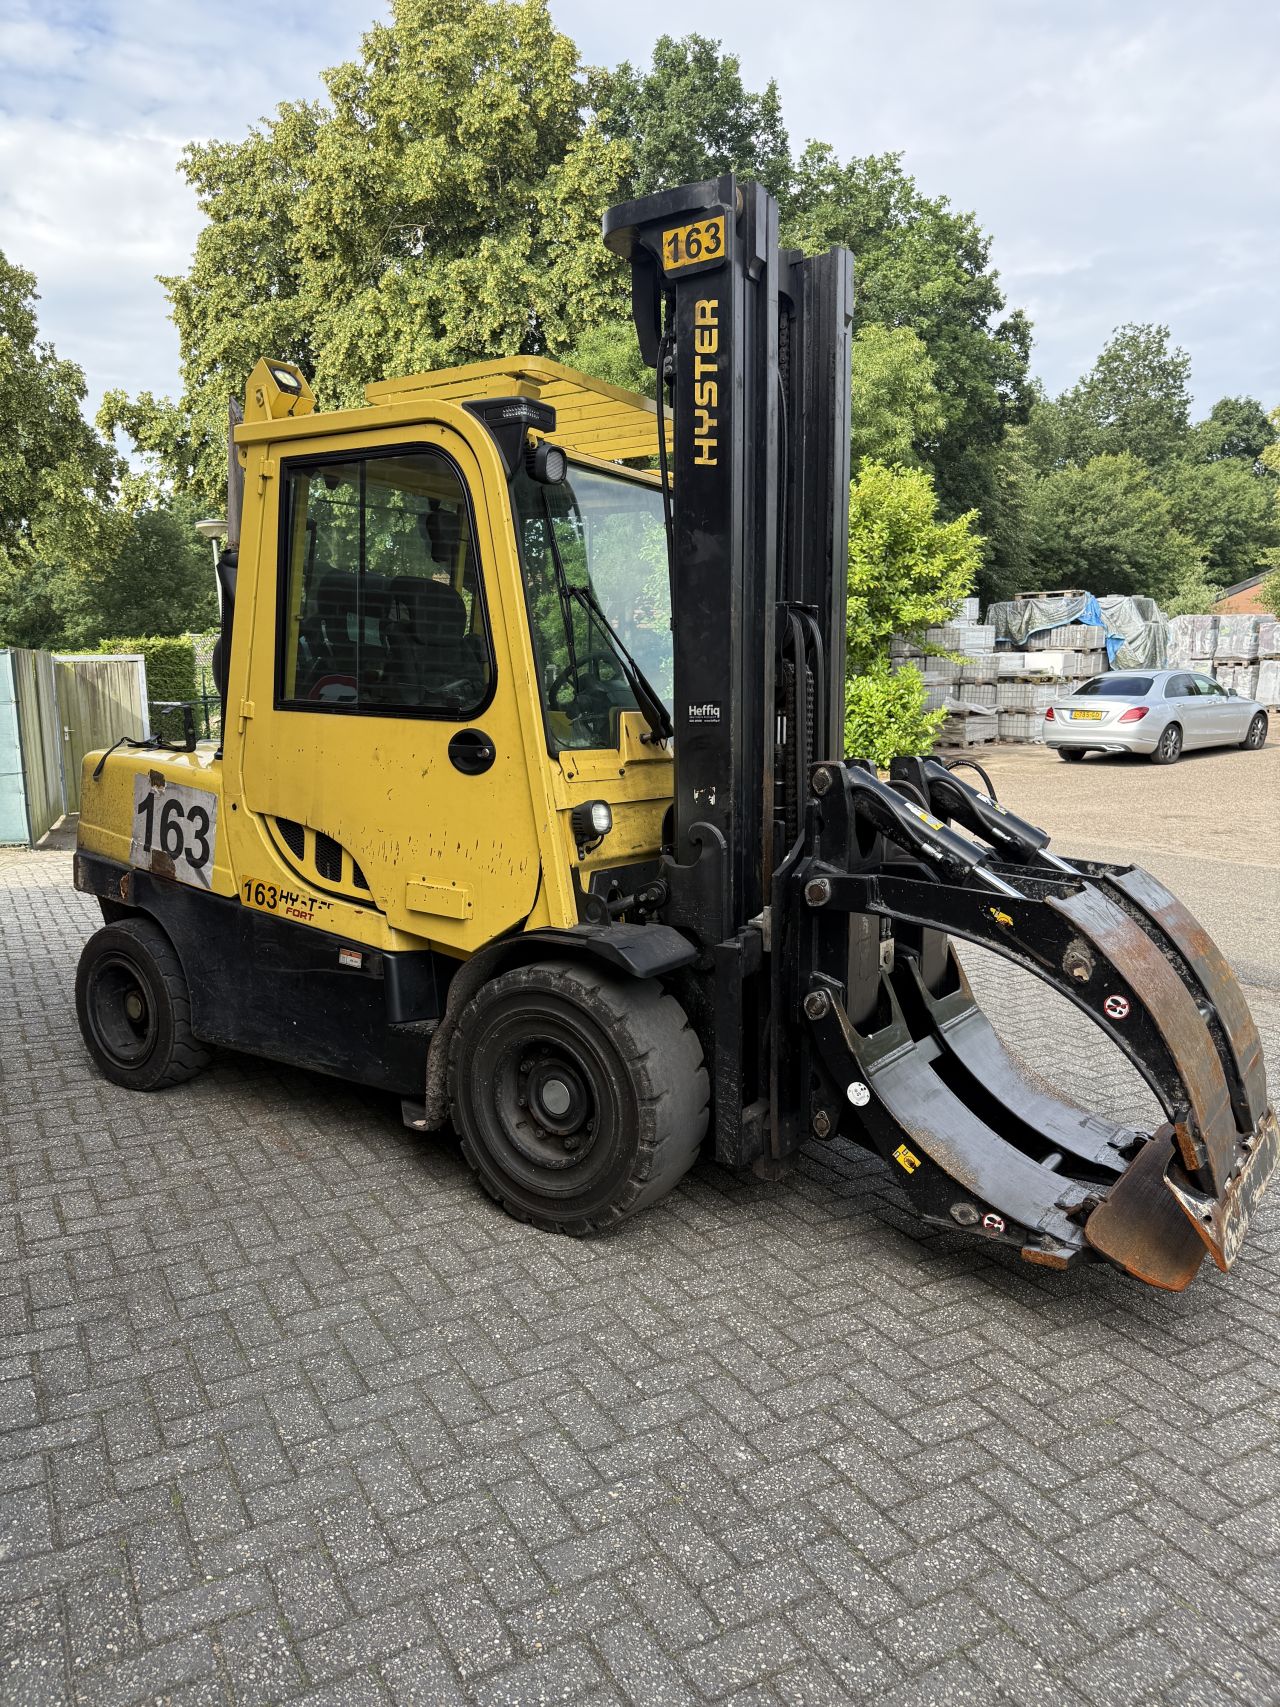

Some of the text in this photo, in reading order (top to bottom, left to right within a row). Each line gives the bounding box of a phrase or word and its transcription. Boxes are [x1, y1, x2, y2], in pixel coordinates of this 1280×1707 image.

[667, 222, 722, 264] 163
[694, 299, 719, 466] HYSTER
[137, 792, 210, 870] 163
[244, 879, 278, 910] 163
[285, 906, 315, 922] FORT
